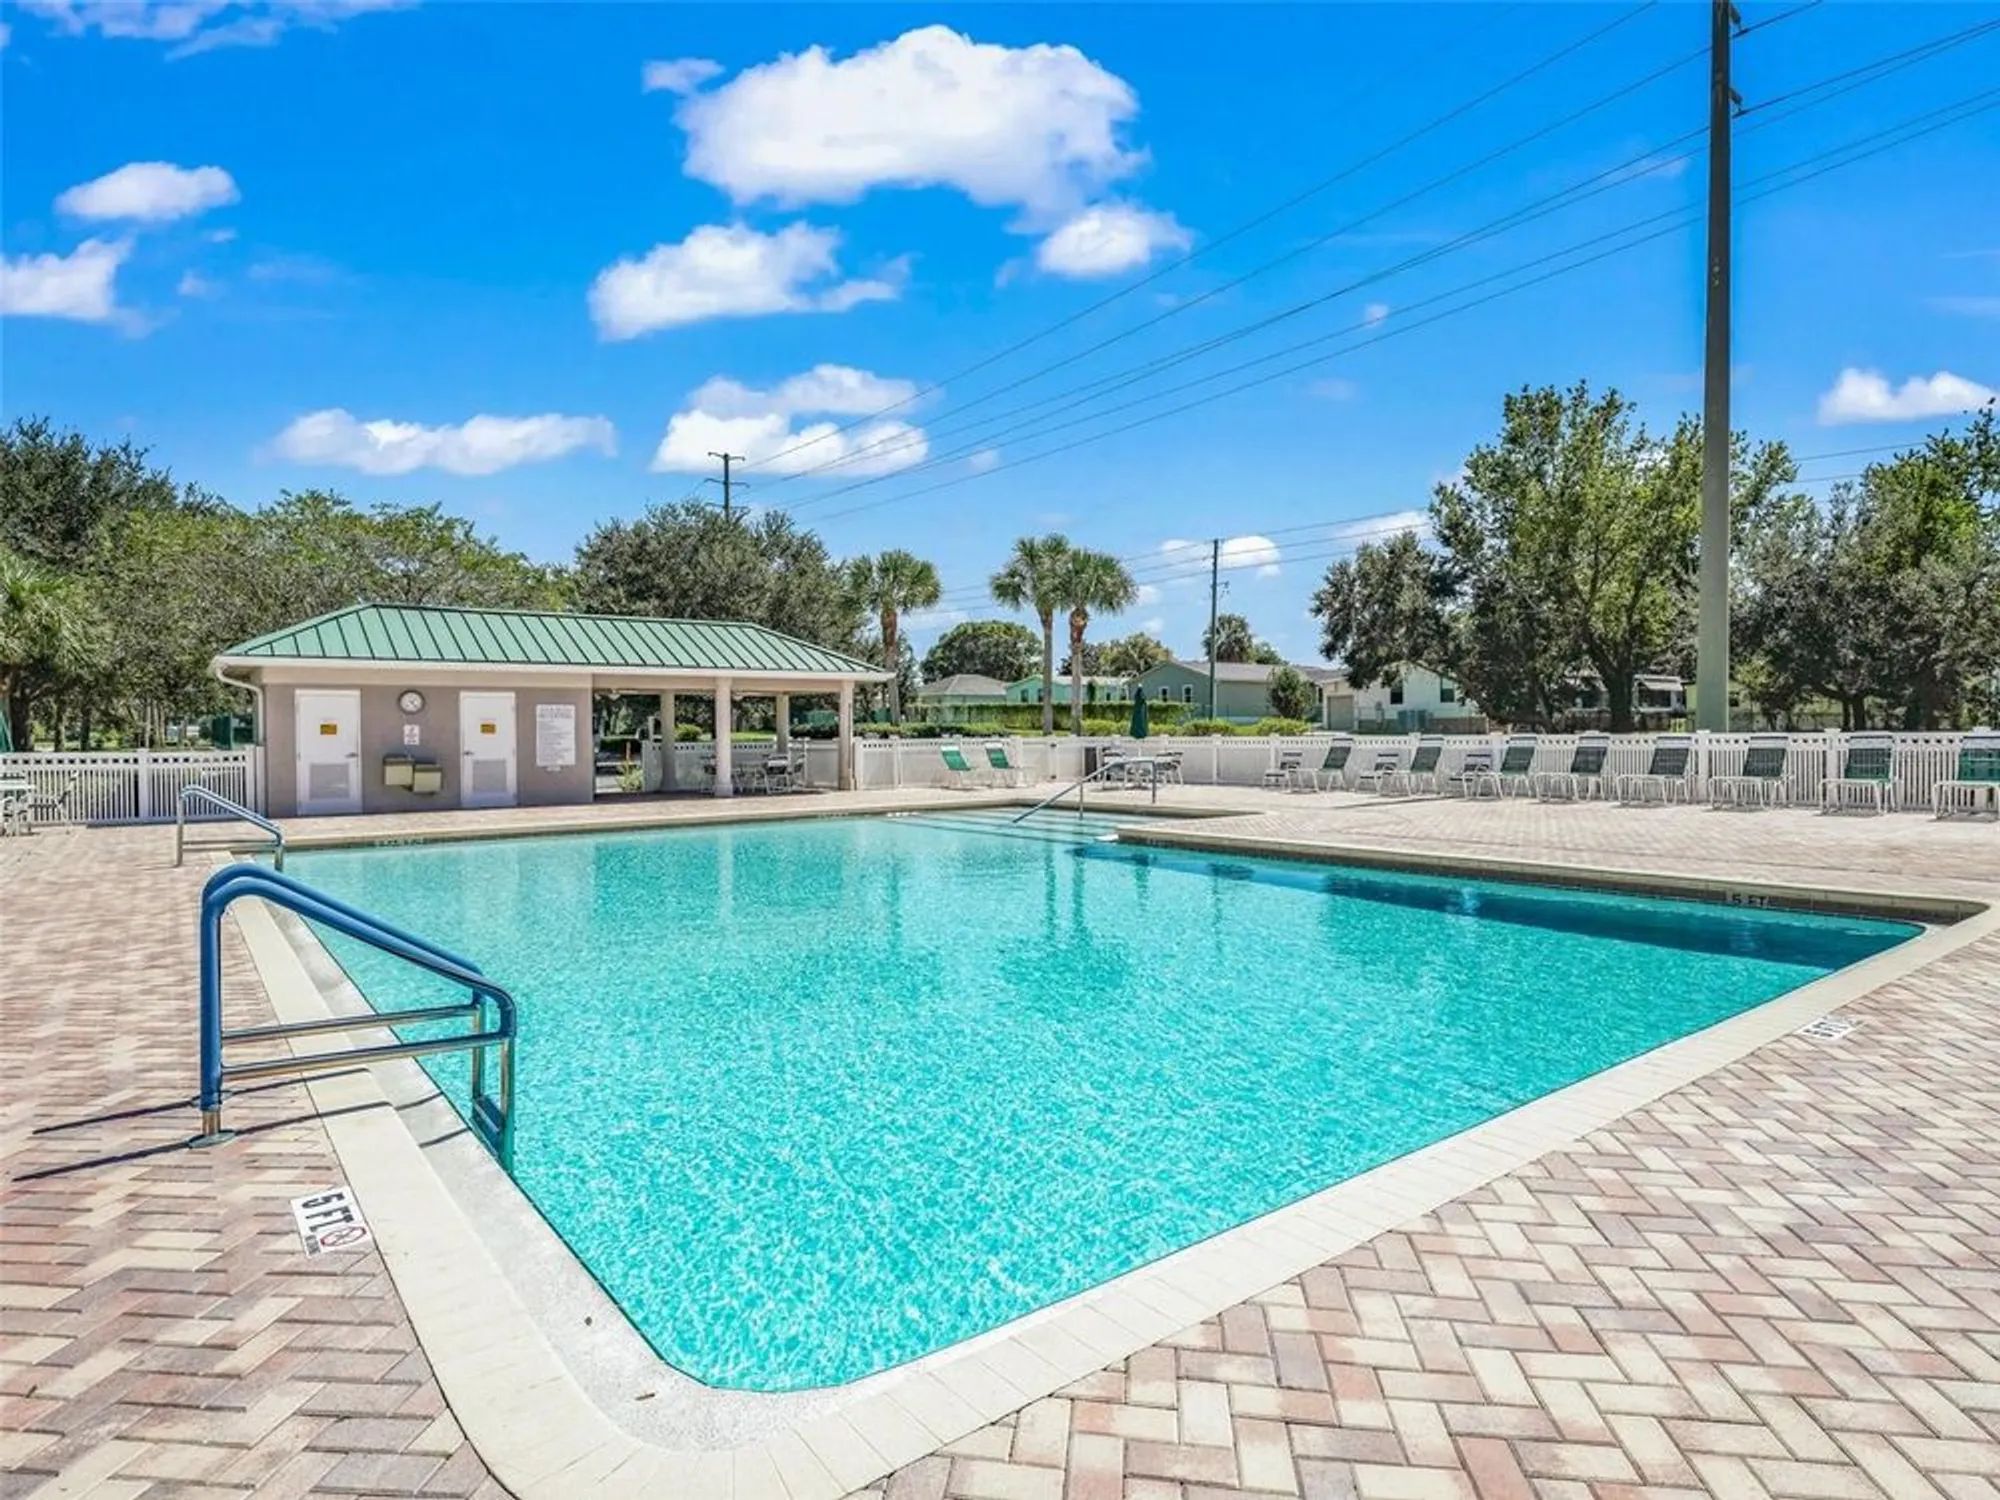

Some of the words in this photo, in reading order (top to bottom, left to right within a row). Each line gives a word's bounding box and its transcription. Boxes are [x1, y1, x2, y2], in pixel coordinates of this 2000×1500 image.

[1733, 893, 1742, 904] 5
[1748, 894, 1767, 905] FT
[302, 1192, 345, 1209] 5
[305, 1206, 355, 1232] FT
